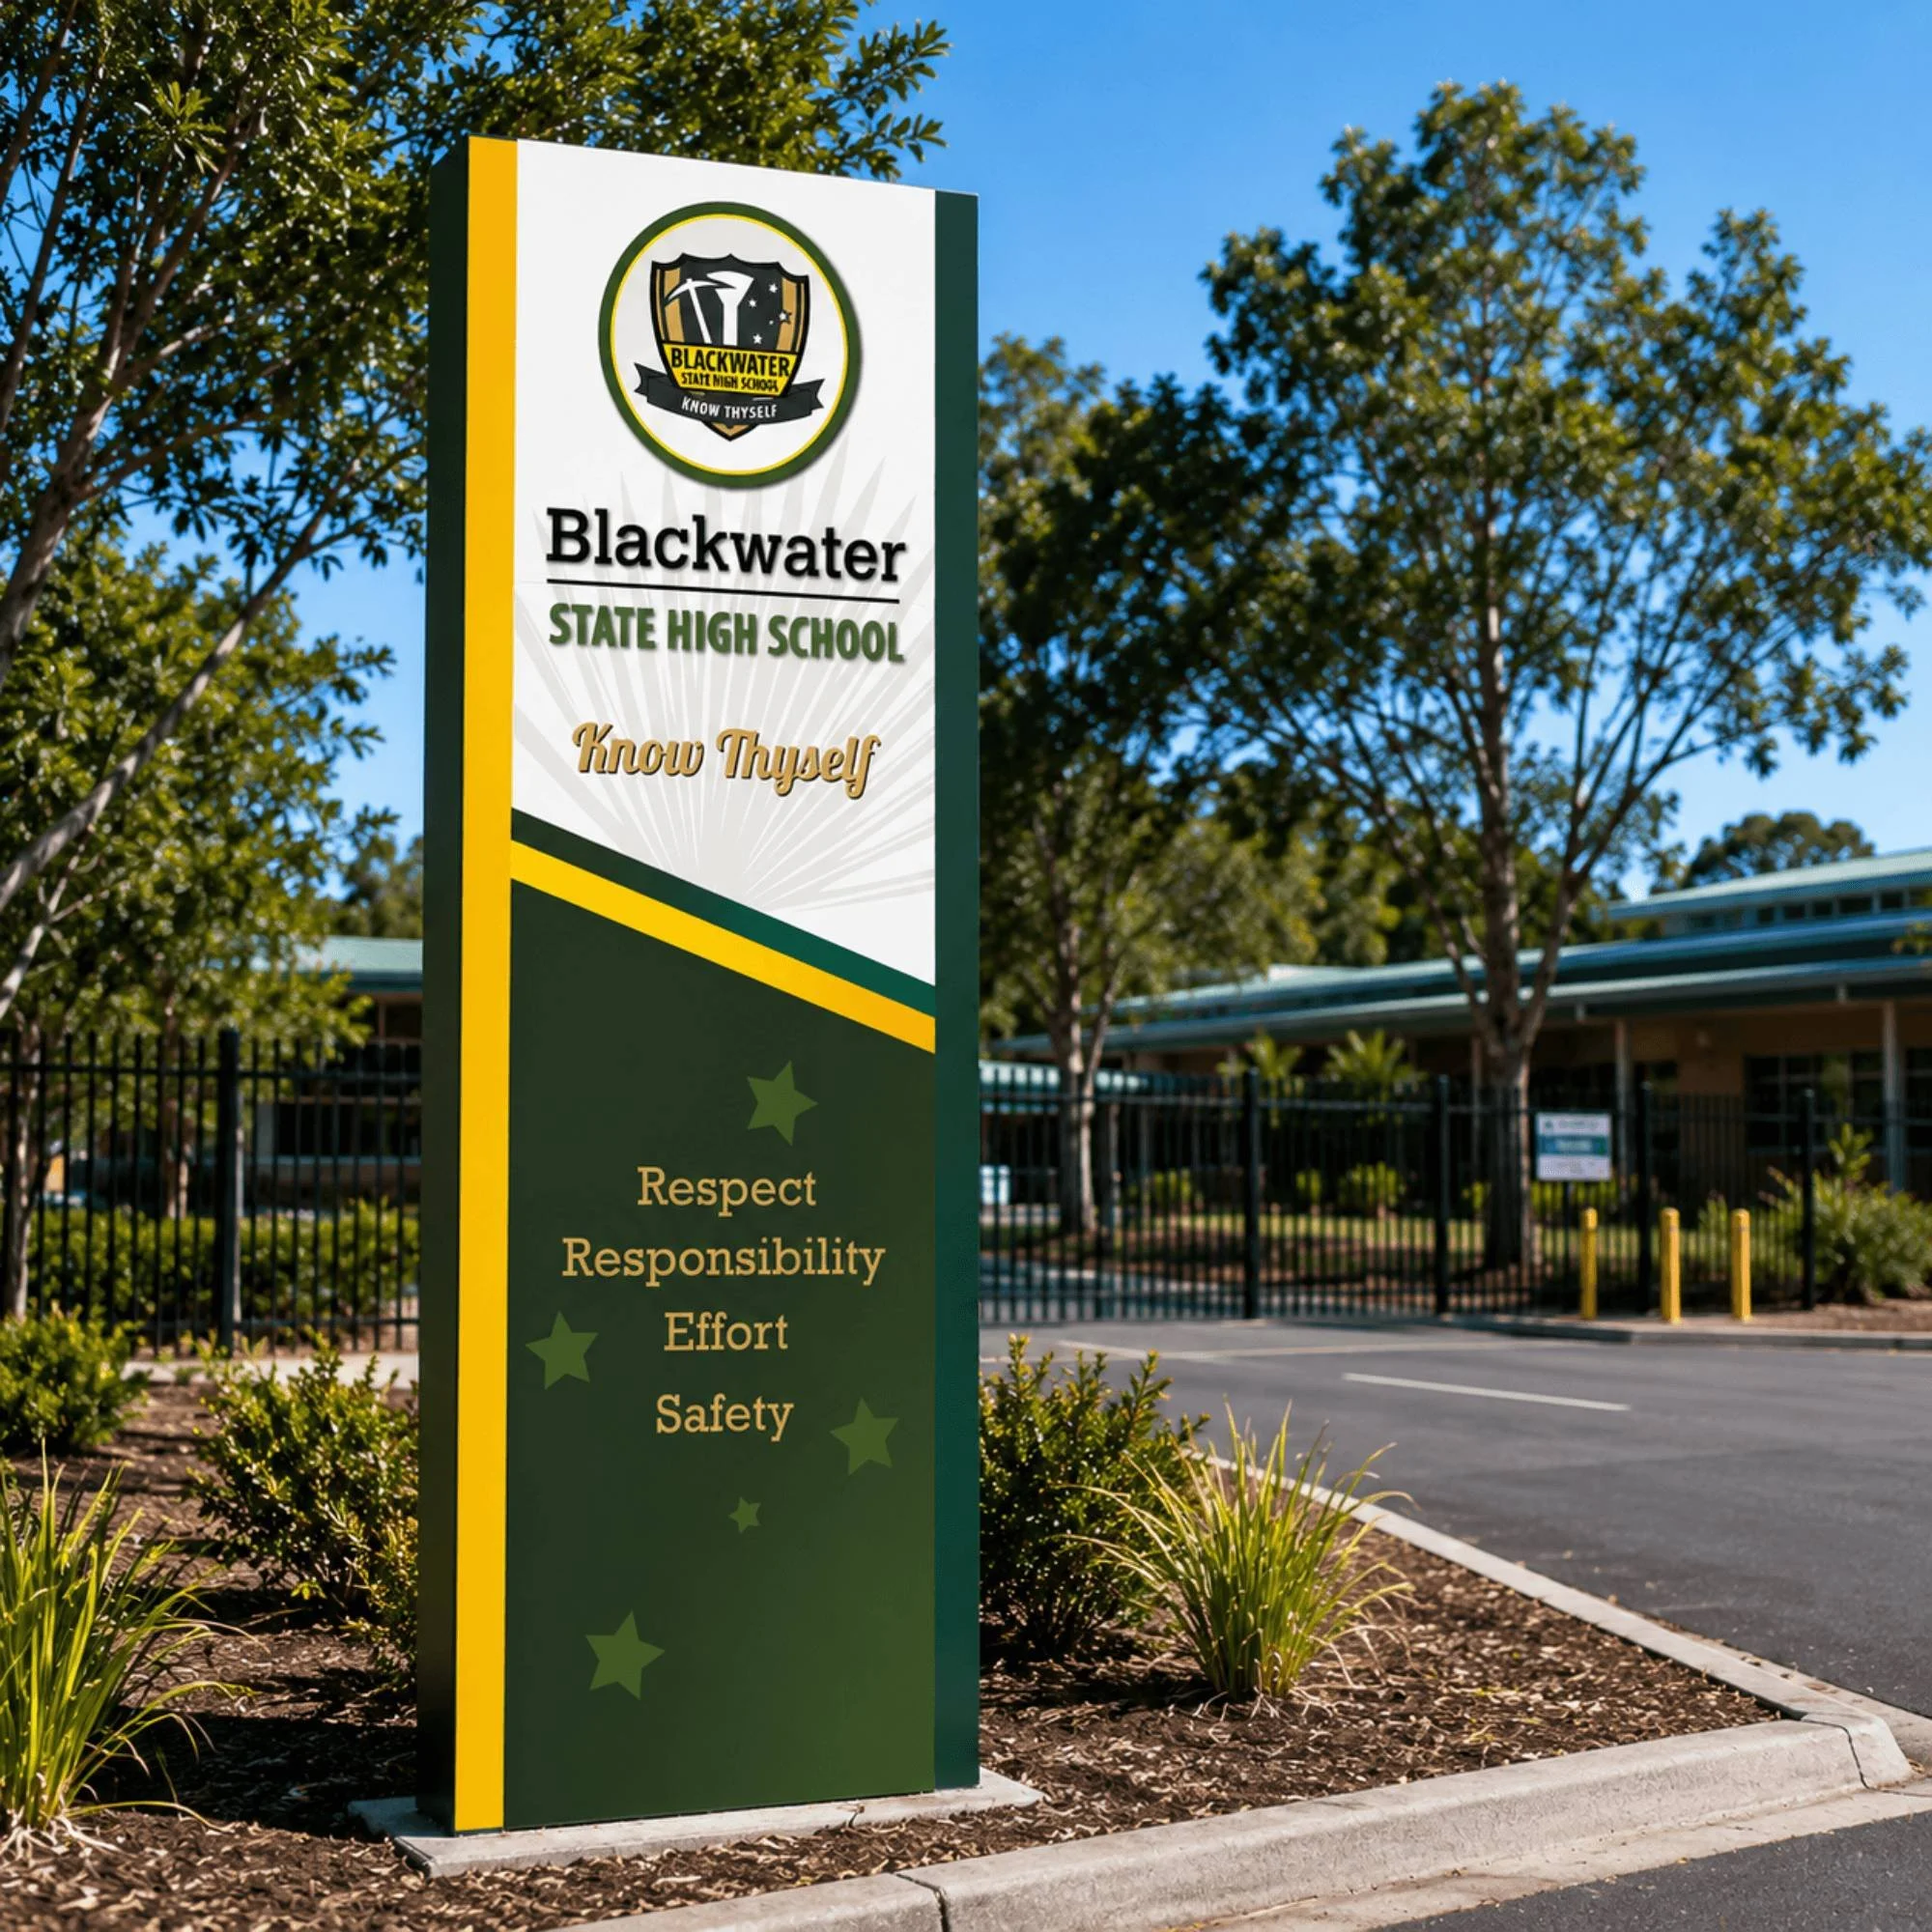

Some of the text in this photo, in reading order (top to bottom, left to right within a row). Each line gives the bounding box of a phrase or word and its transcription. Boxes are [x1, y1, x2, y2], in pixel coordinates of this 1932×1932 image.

[671, 348, 790, 377] BLACKWATER
[681, 372, 710, 386] STATE
[682, 396, 778, 419] KNOW THYSELF
[547, 507, 906, 582] Blackwater
[549, 603, 905, 663] STATE HIGH SCHOOL
[572, 722, 881, 799] Know Thyself
[637, 1166, 816, 1217] Respect
[562, 1236, 886, 1287] Responsibility
[664, 1311, 788, 1351] Effort
[656, 1393, 794, 1441] Safety
